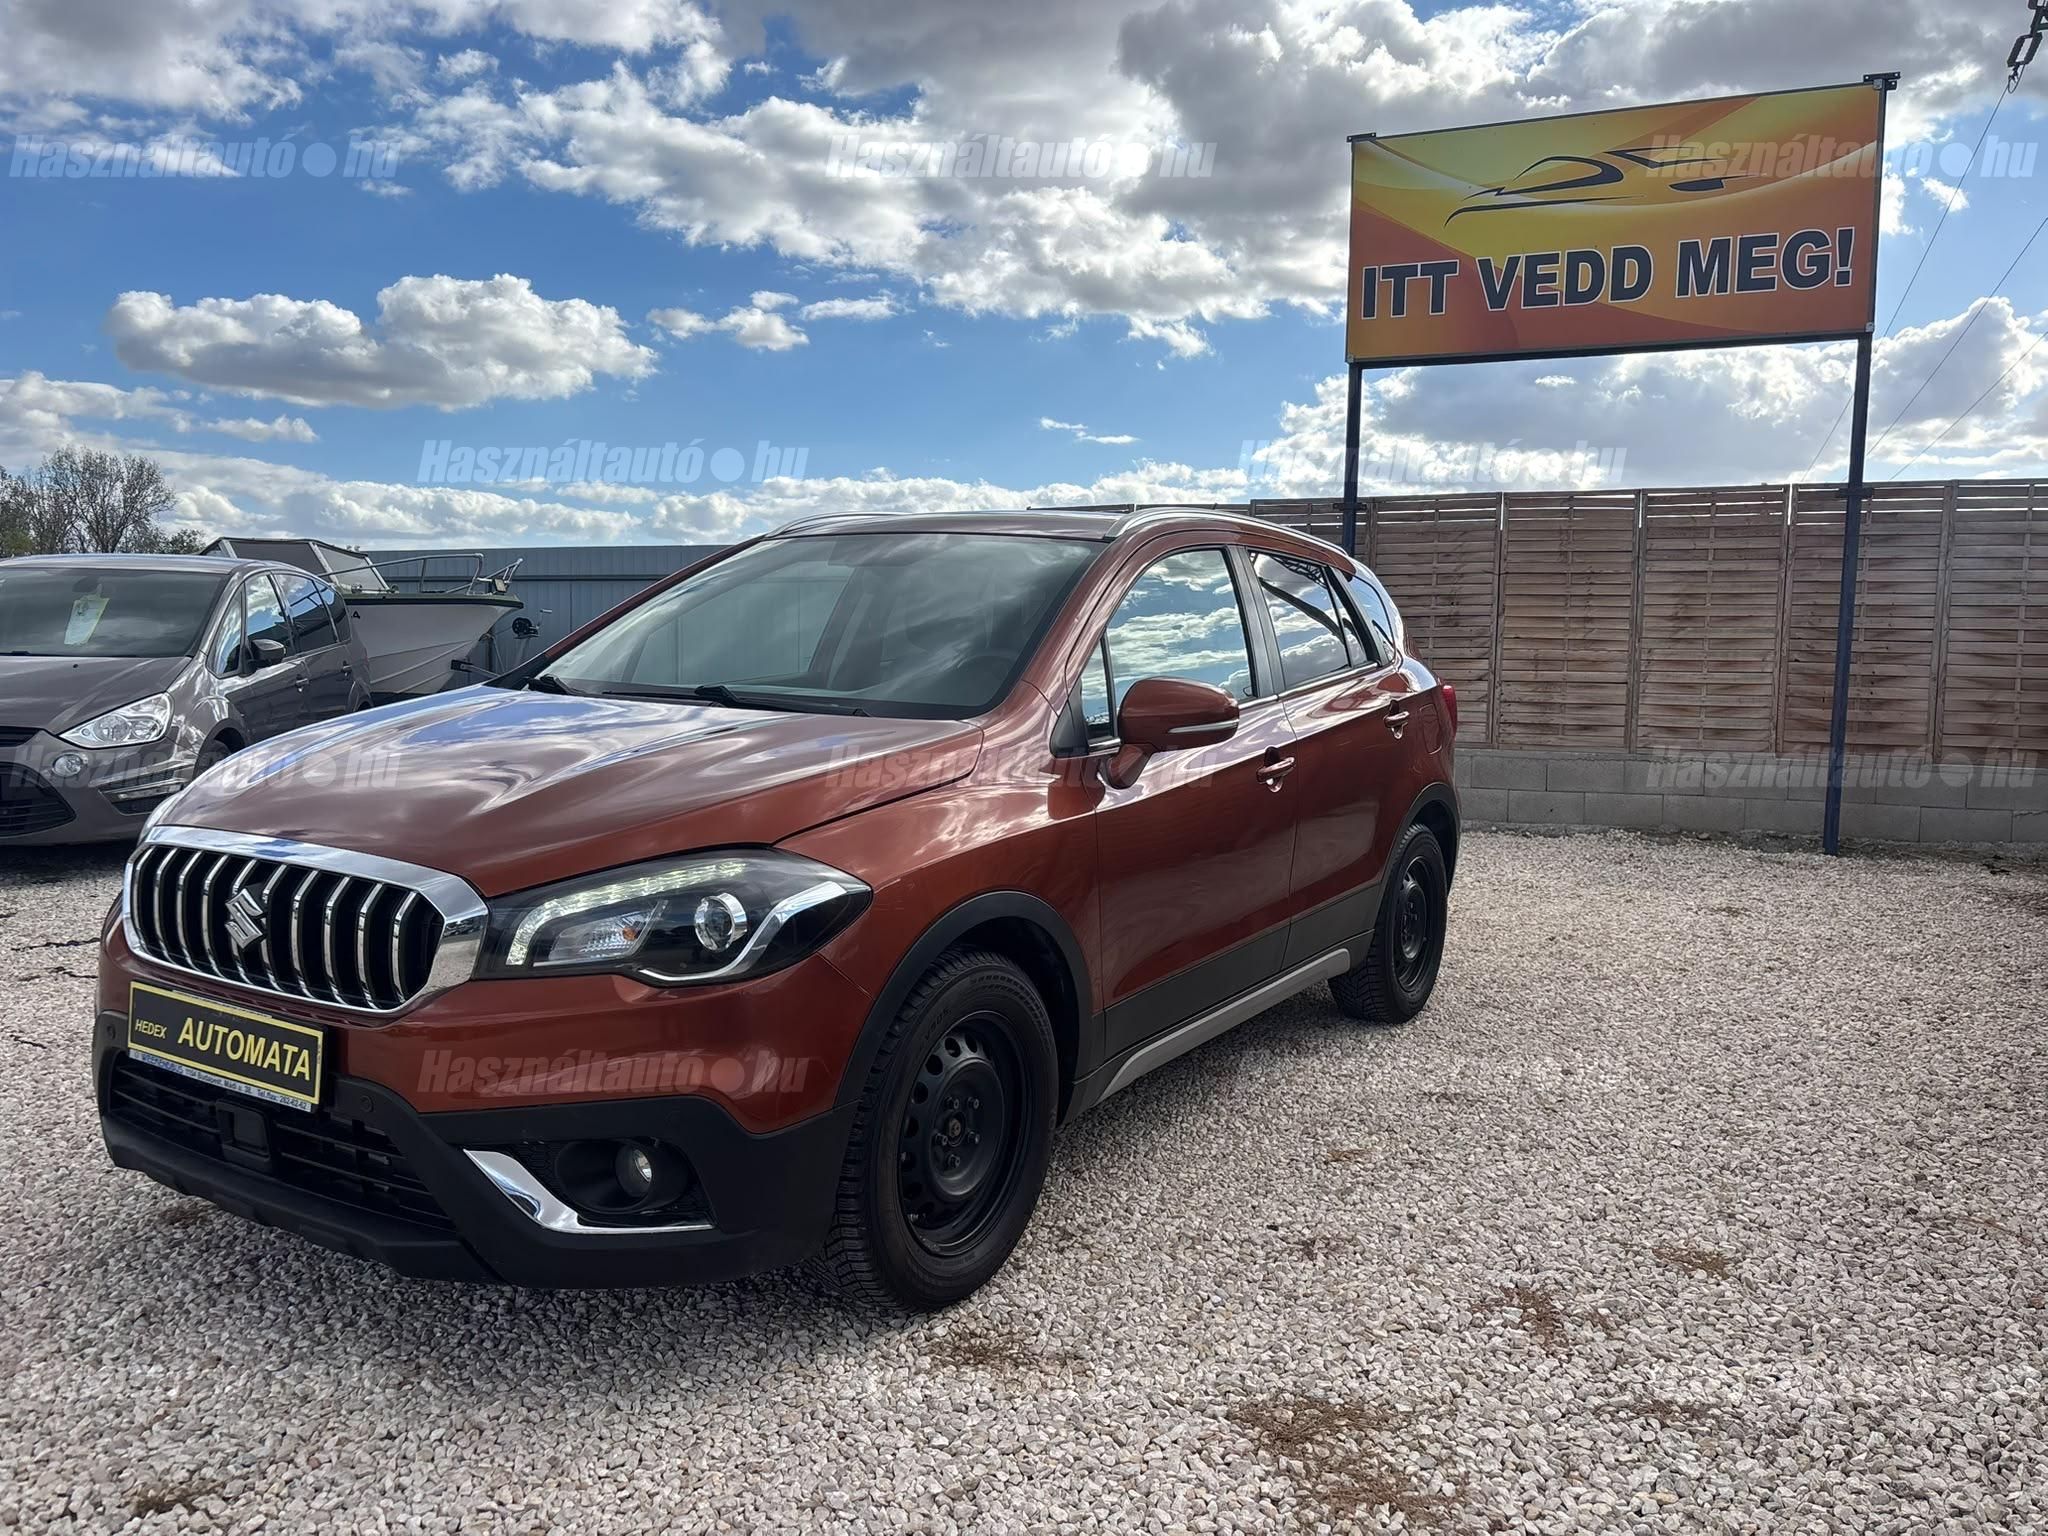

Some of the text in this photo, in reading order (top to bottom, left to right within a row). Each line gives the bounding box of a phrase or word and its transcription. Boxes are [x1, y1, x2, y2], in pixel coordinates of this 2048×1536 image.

[1361, 226, 1855, 320] ITT VEDD MEG!
[135, 1019, 167, 1039] HEDEX
[177, 1017, 310, 1081] AUTOMATA
